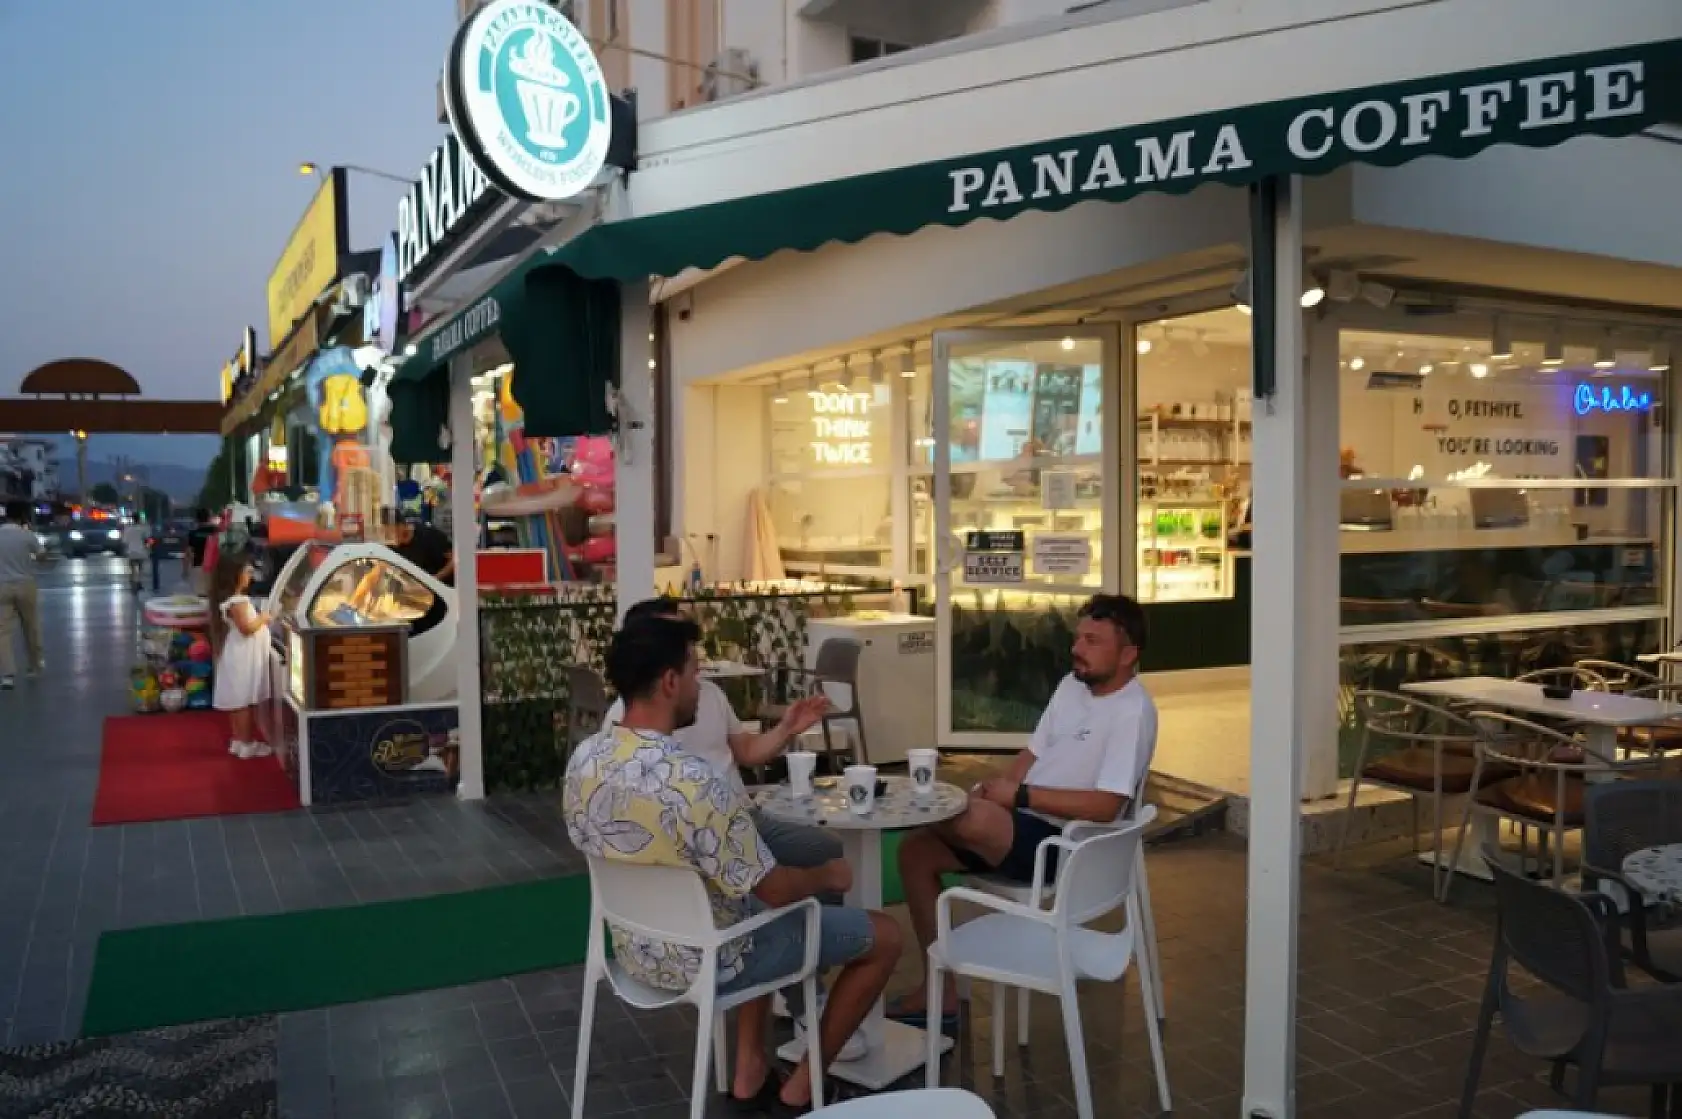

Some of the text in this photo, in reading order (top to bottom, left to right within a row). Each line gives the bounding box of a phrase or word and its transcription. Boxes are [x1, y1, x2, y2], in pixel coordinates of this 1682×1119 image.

[947, 61, 1645, 213] PANAMA COFFEE
[808, 391, 871, 414] DON'T
[811, 416, 872, 438] THINK
[810, 441, 872, 464] TWICE
[1496, 438, 1559, 456] LOOKING
